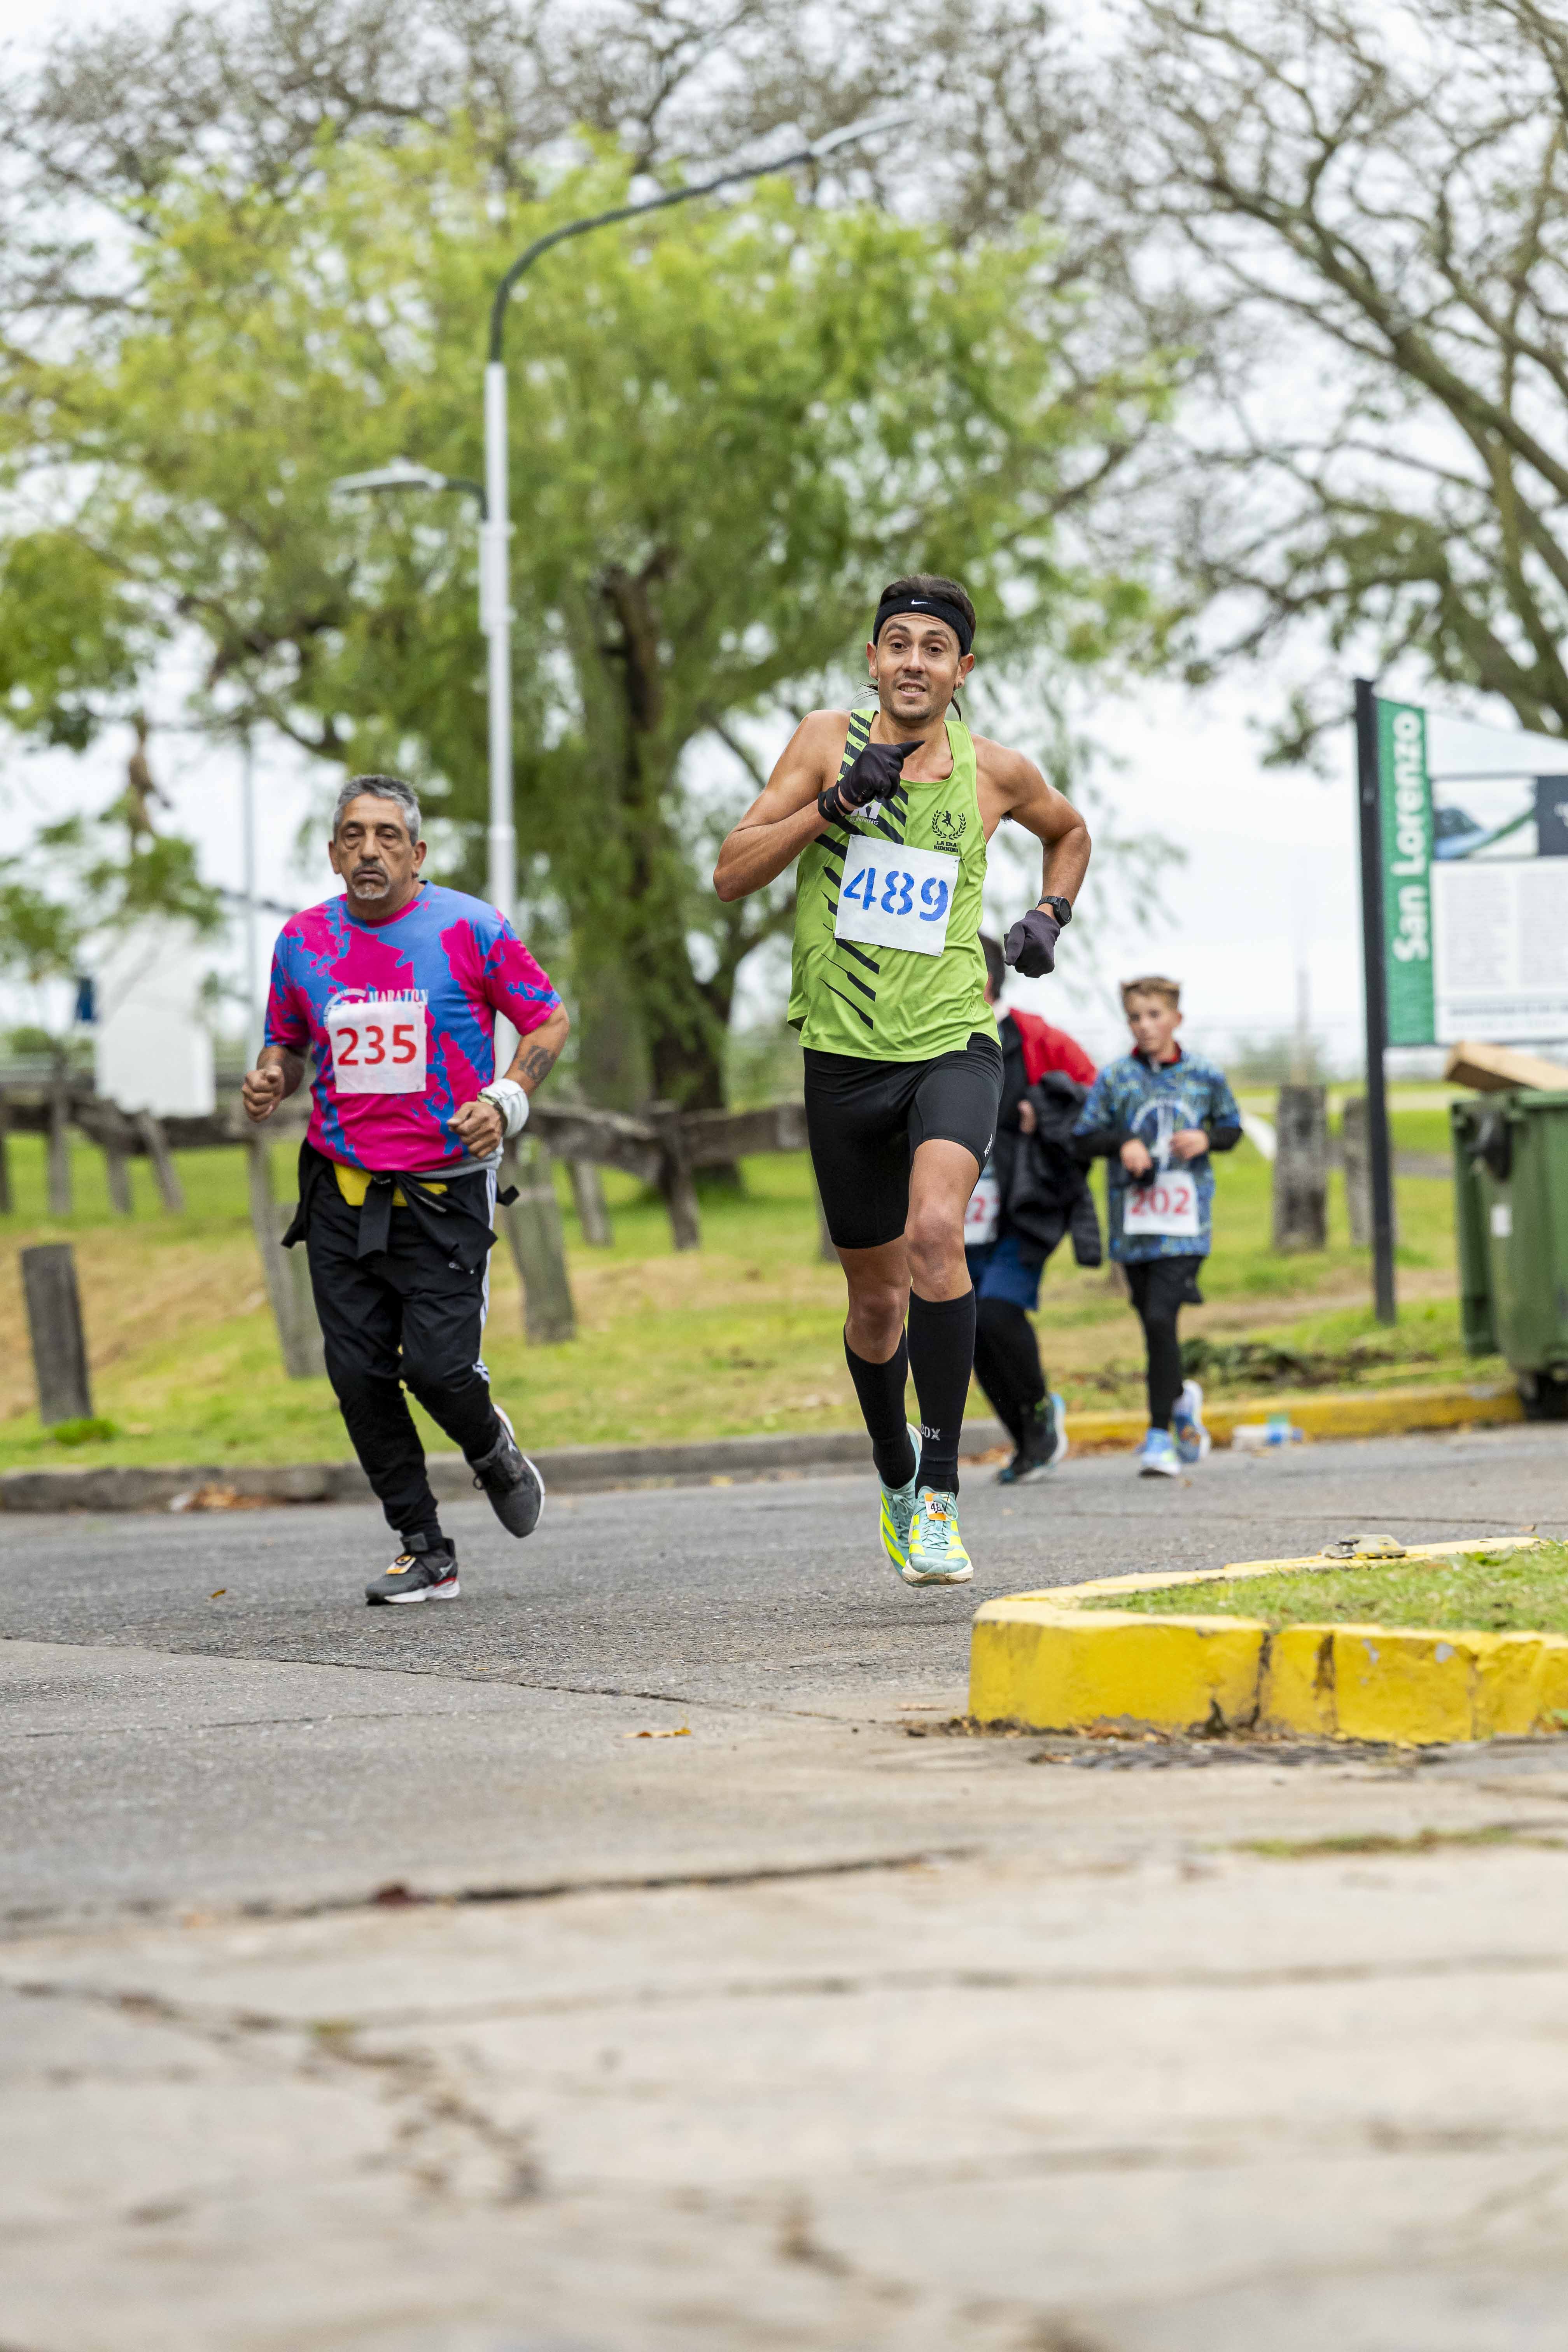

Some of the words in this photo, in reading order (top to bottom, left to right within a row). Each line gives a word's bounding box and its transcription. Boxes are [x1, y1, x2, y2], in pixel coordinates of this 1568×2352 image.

[1391, 710, 1426, 876] Lorenzo
[849, 817, 879, 825] RUNNING
[843, 867, 948, 922] 489
[1392, 884, 1430, 962] San
[336, 1024, 417, 1066] 235
[1130, 1186, 1190, 1216] 202
